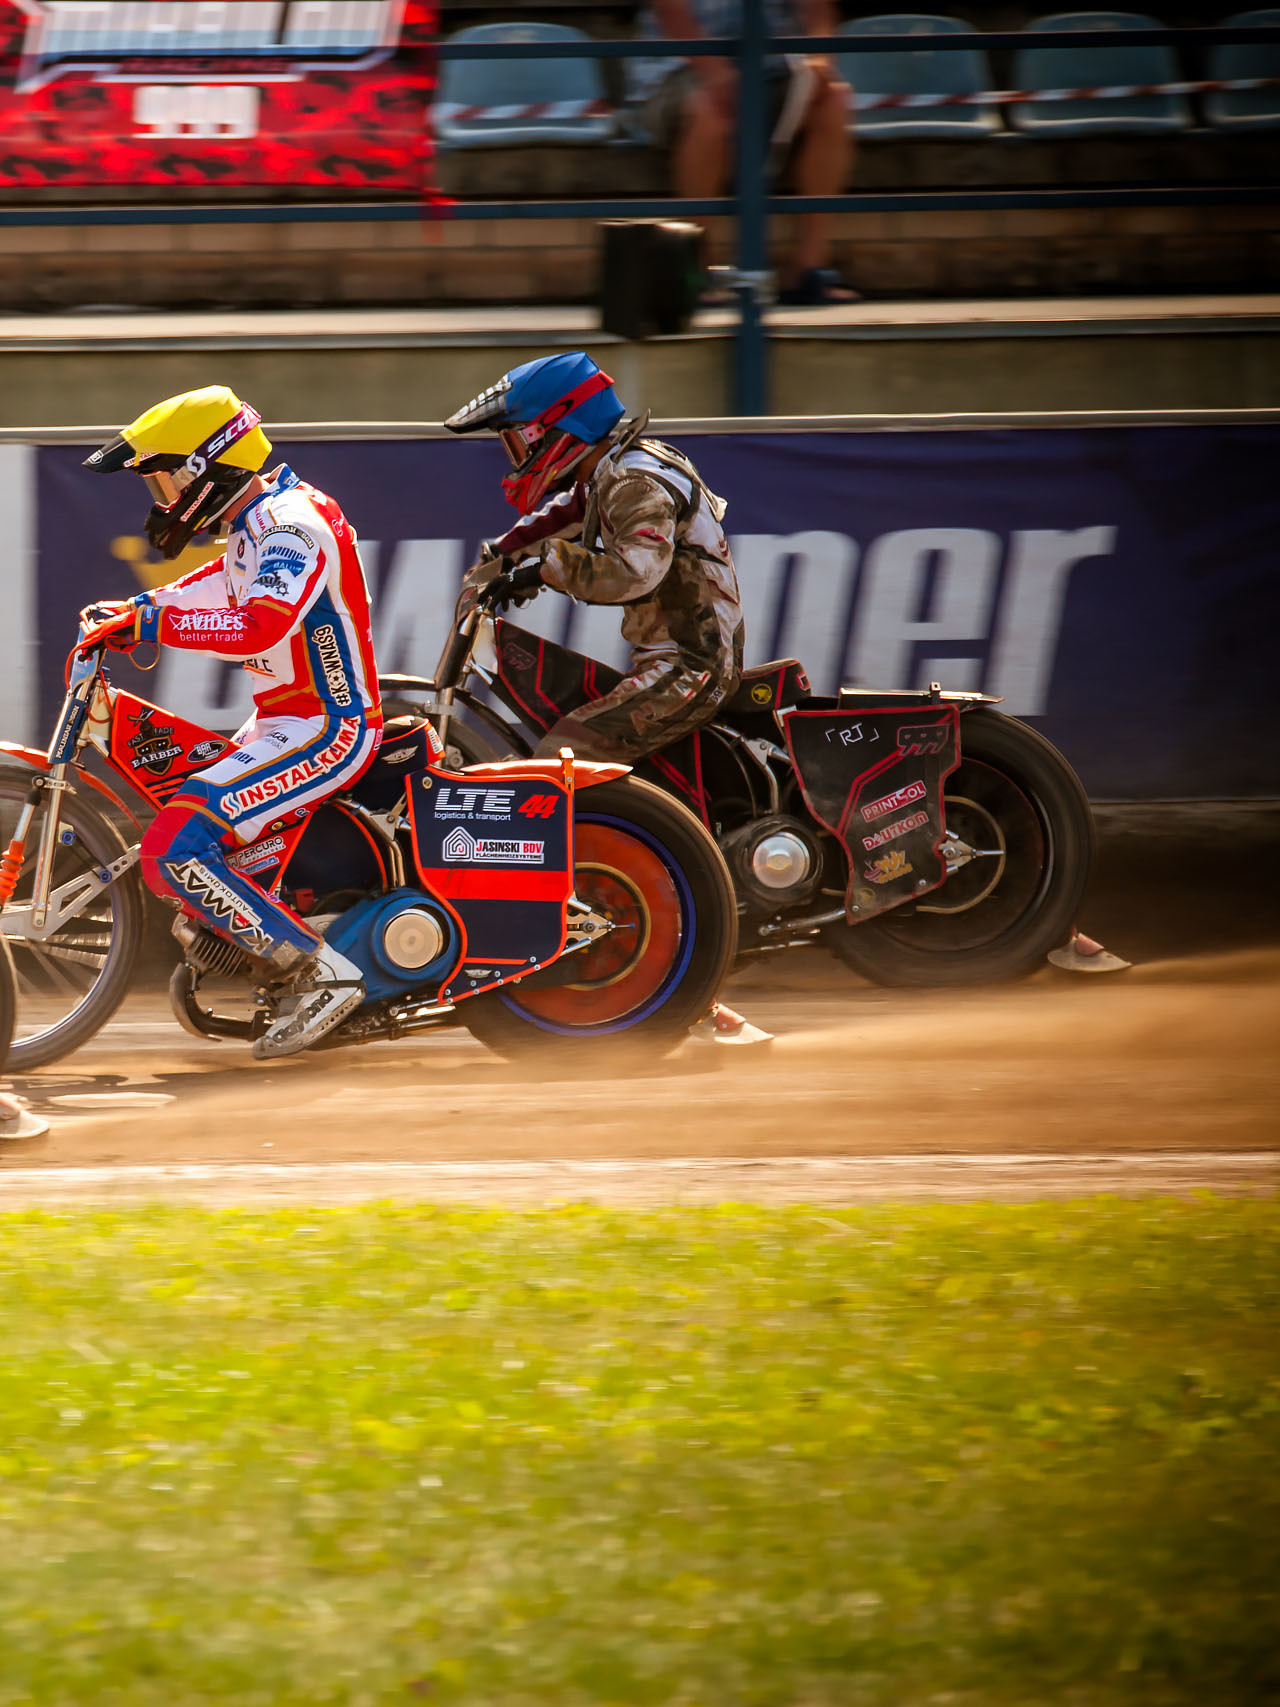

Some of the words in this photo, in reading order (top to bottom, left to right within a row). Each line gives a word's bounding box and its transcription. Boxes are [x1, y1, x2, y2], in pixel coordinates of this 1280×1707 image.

[179, 613, 244, 631] AVIDES
[179, 632, 211, 642] better
[215, 632, 244, 642] trade
[132, 746, 183, 768] BARBER
[237, 716, 360, 810] INSTAL-KLIMA
[435, 788, 515, 813] LTE
[518, 794, 560, 819] 44
[434, 811, 466, 821] logistics
[468, 811, 474, 820] &
[476, 812, 511, 822] transport
[238, 836, 284, 859] PERCURO
[476, 841, 520, 854] JASINSKI
[523, 842, 542, 854] BDV
[198, 864, 250, 912] AUTOKOMIS
